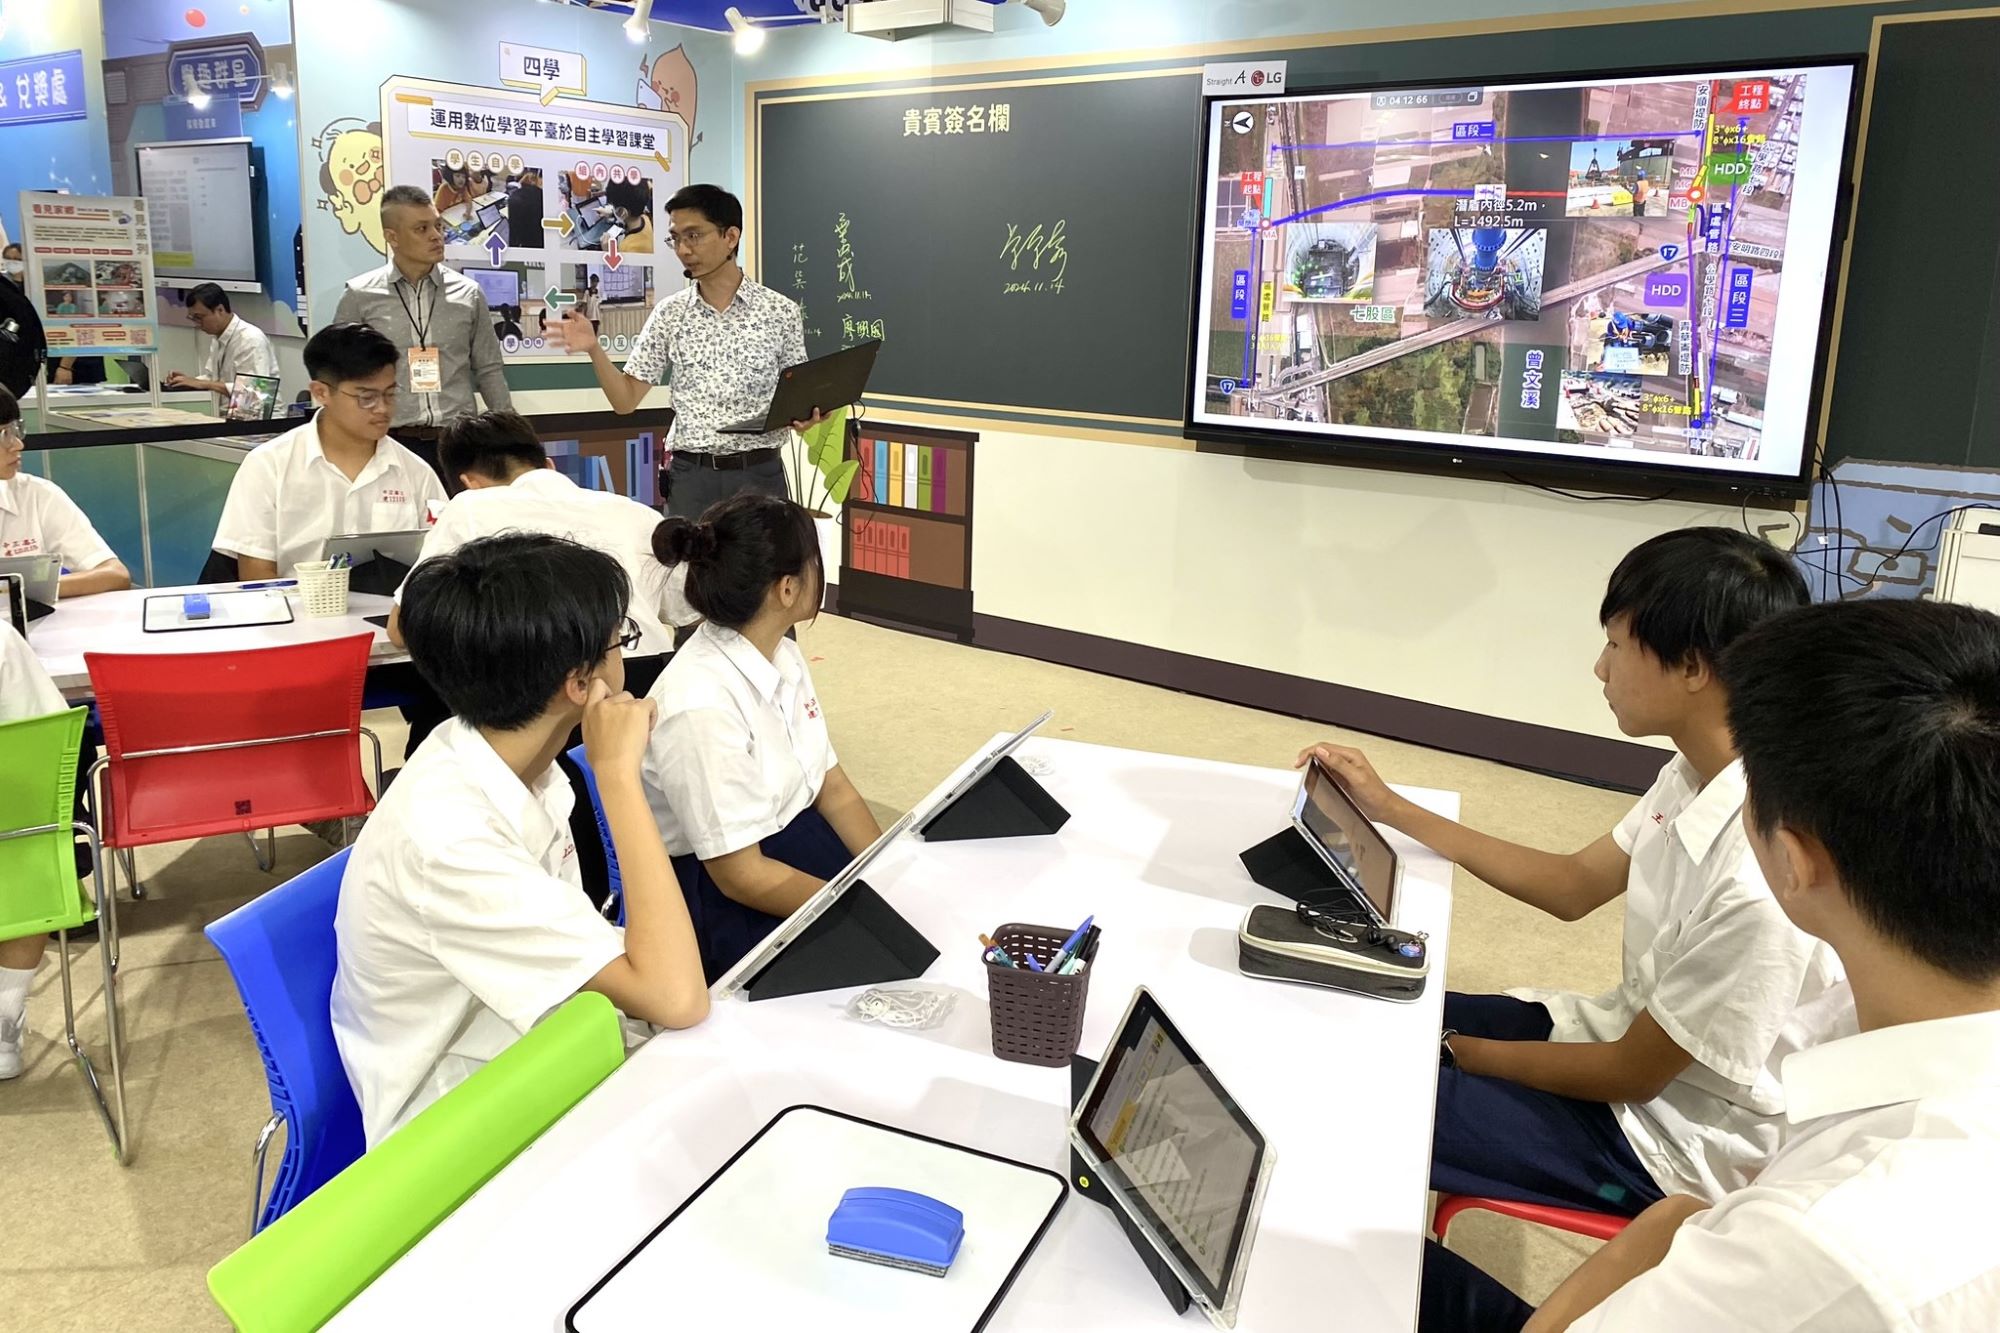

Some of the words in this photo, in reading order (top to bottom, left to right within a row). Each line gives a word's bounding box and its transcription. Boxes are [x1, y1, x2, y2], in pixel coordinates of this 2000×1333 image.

[523, 57, 560, 80] 四學
[1206, 78, 1233, 87] Straight
[1234, 70, 1246, 84] A
[1266, 72, 1282, 83] LG
[1741, 84, 1764, 96] 工程
[1738, 98, 1762, 110] 終點
[902, 104, 1011, 136] 貴賓簽名欄
[430, 107, 656, 151] 運用數位學習平臺於自主學習課堂
[1455, 123, 1493, 138] 區段二
[449, 152, 523, 172] 學生自學
[1714, 163, 1746, 174] HDD
[578, 163, 639, 182] 組內共學
[1669, 198, 1688, 208] MB
[1454, 215, 1524, 228] L=1492.5m
[1234, 274, 1246, 310] 區段一
[1651, 284, 1682, 296] HDD
[1730, 273, 1749, 322] 區段三
[1351, 306, 1394, 321] 七股區
[1521, 350, 1543, 408] 曾文溪
